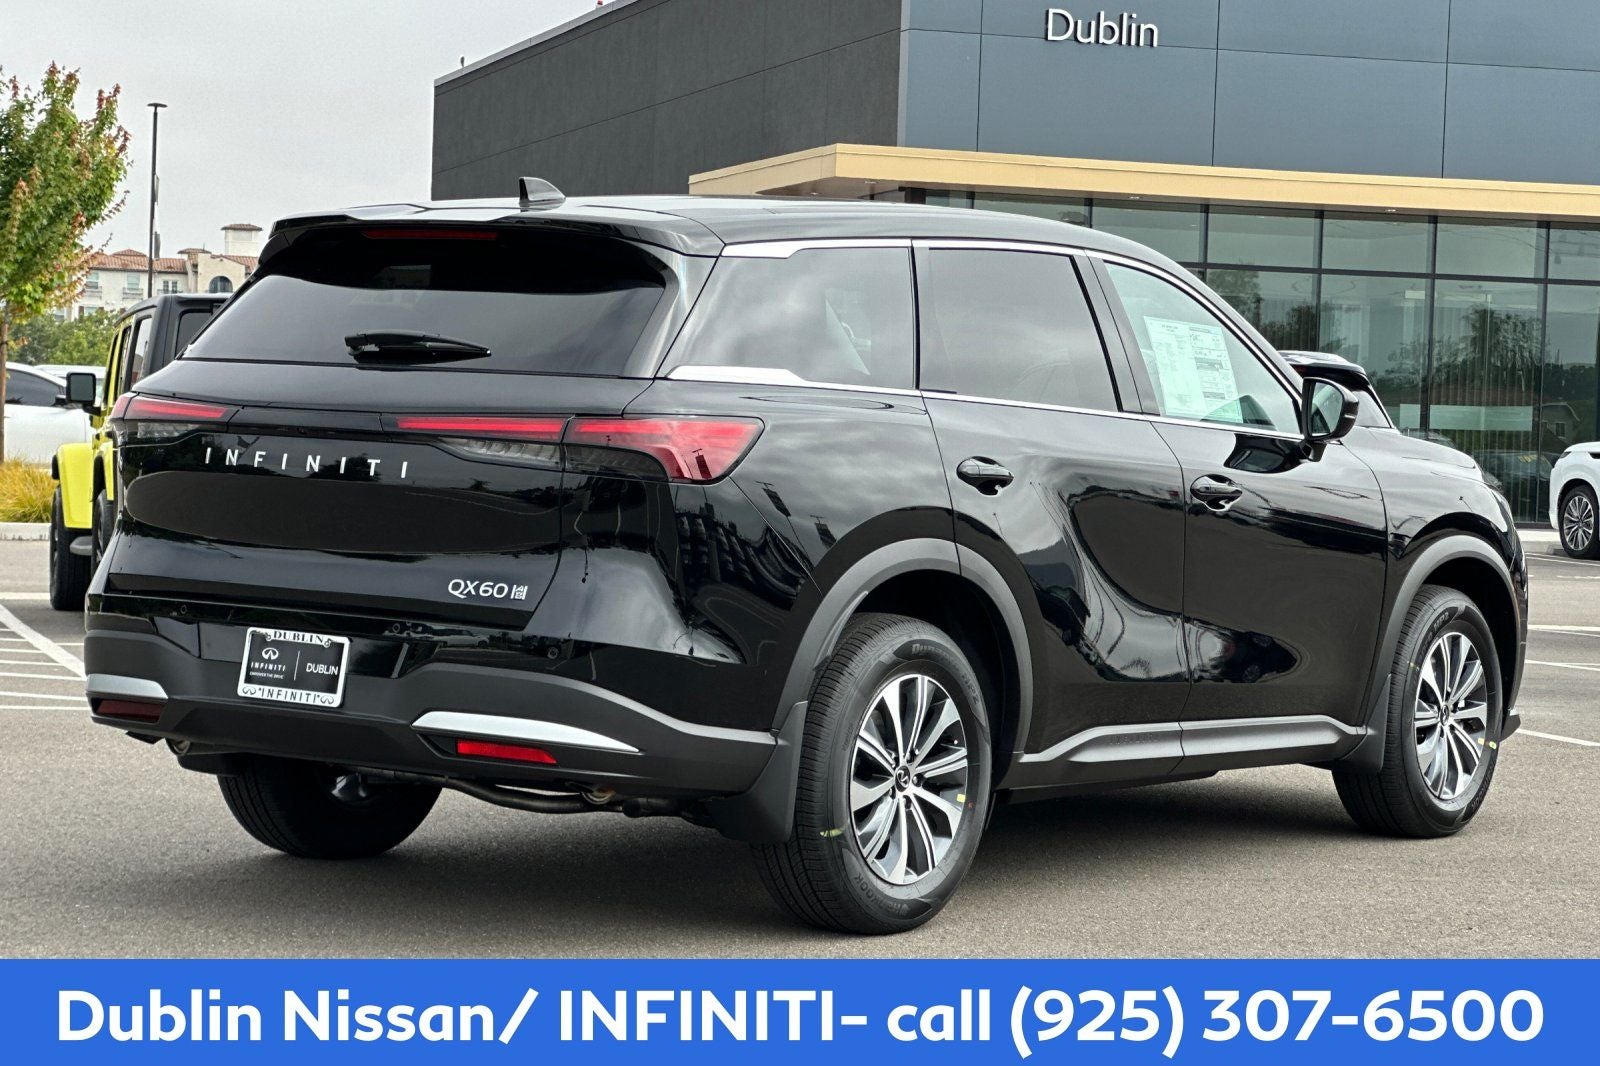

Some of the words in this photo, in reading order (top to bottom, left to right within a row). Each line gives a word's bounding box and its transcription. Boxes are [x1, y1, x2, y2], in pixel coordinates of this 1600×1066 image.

[1046, 8, 1159, 48] Dublin
[205, 447, 408, 479] INFINITI
[447, 578, 508, 599] QX60
[273, 630, 324, 645] DUBLIN
[250, 661, 286, 672] INFINITI
[305, 662, 339, 676] DUBLIN
